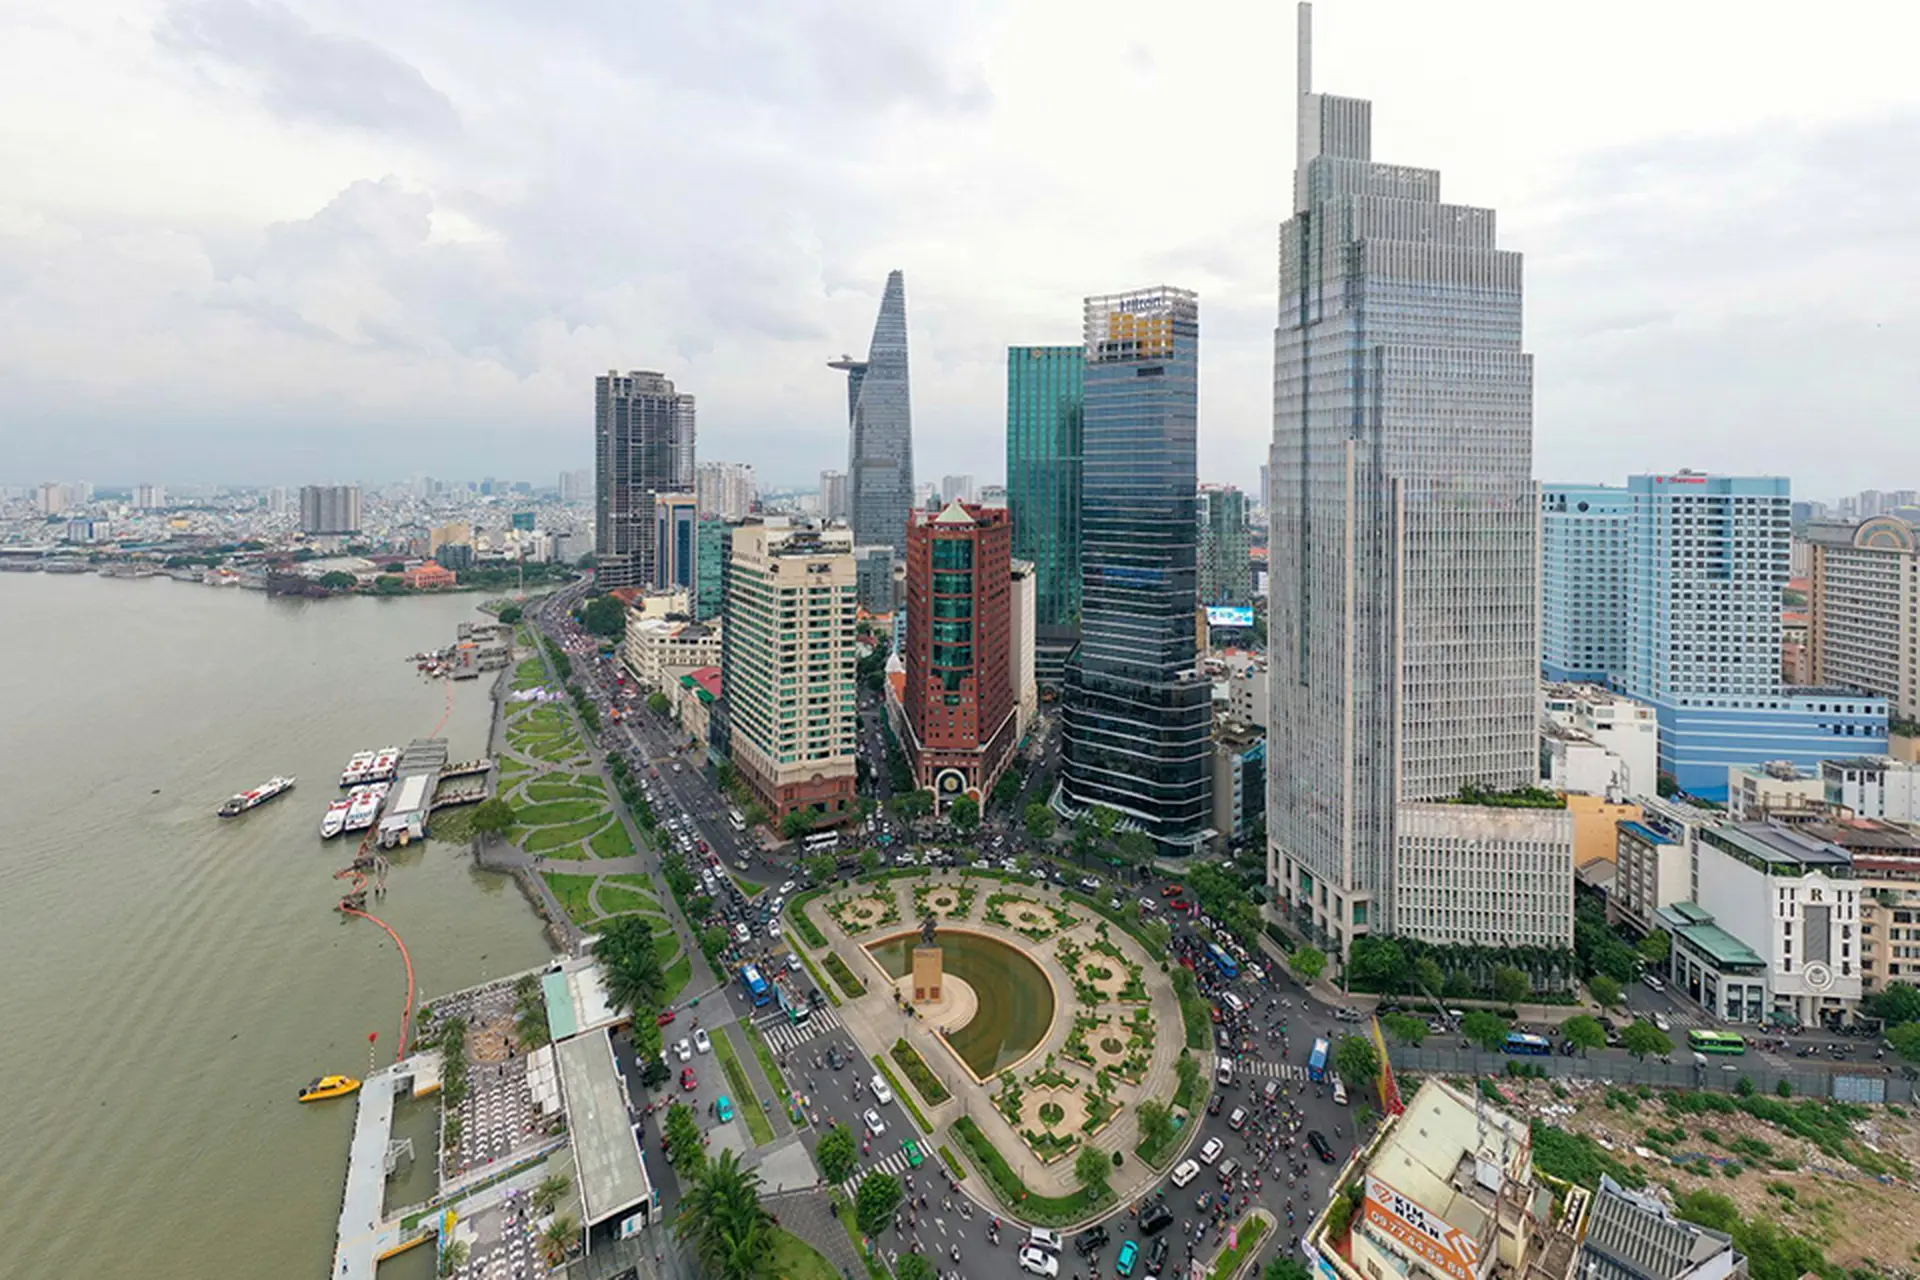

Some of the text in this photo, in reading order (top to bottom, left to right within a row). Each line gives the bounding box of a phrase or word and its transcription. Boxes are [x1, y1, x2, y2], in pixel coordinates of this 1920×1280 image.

[1811, 888, 1823, 901] R
[1395, 1196, 1424, 1219] KIM
[1395, 1206, 1439, 1239] NGAN
